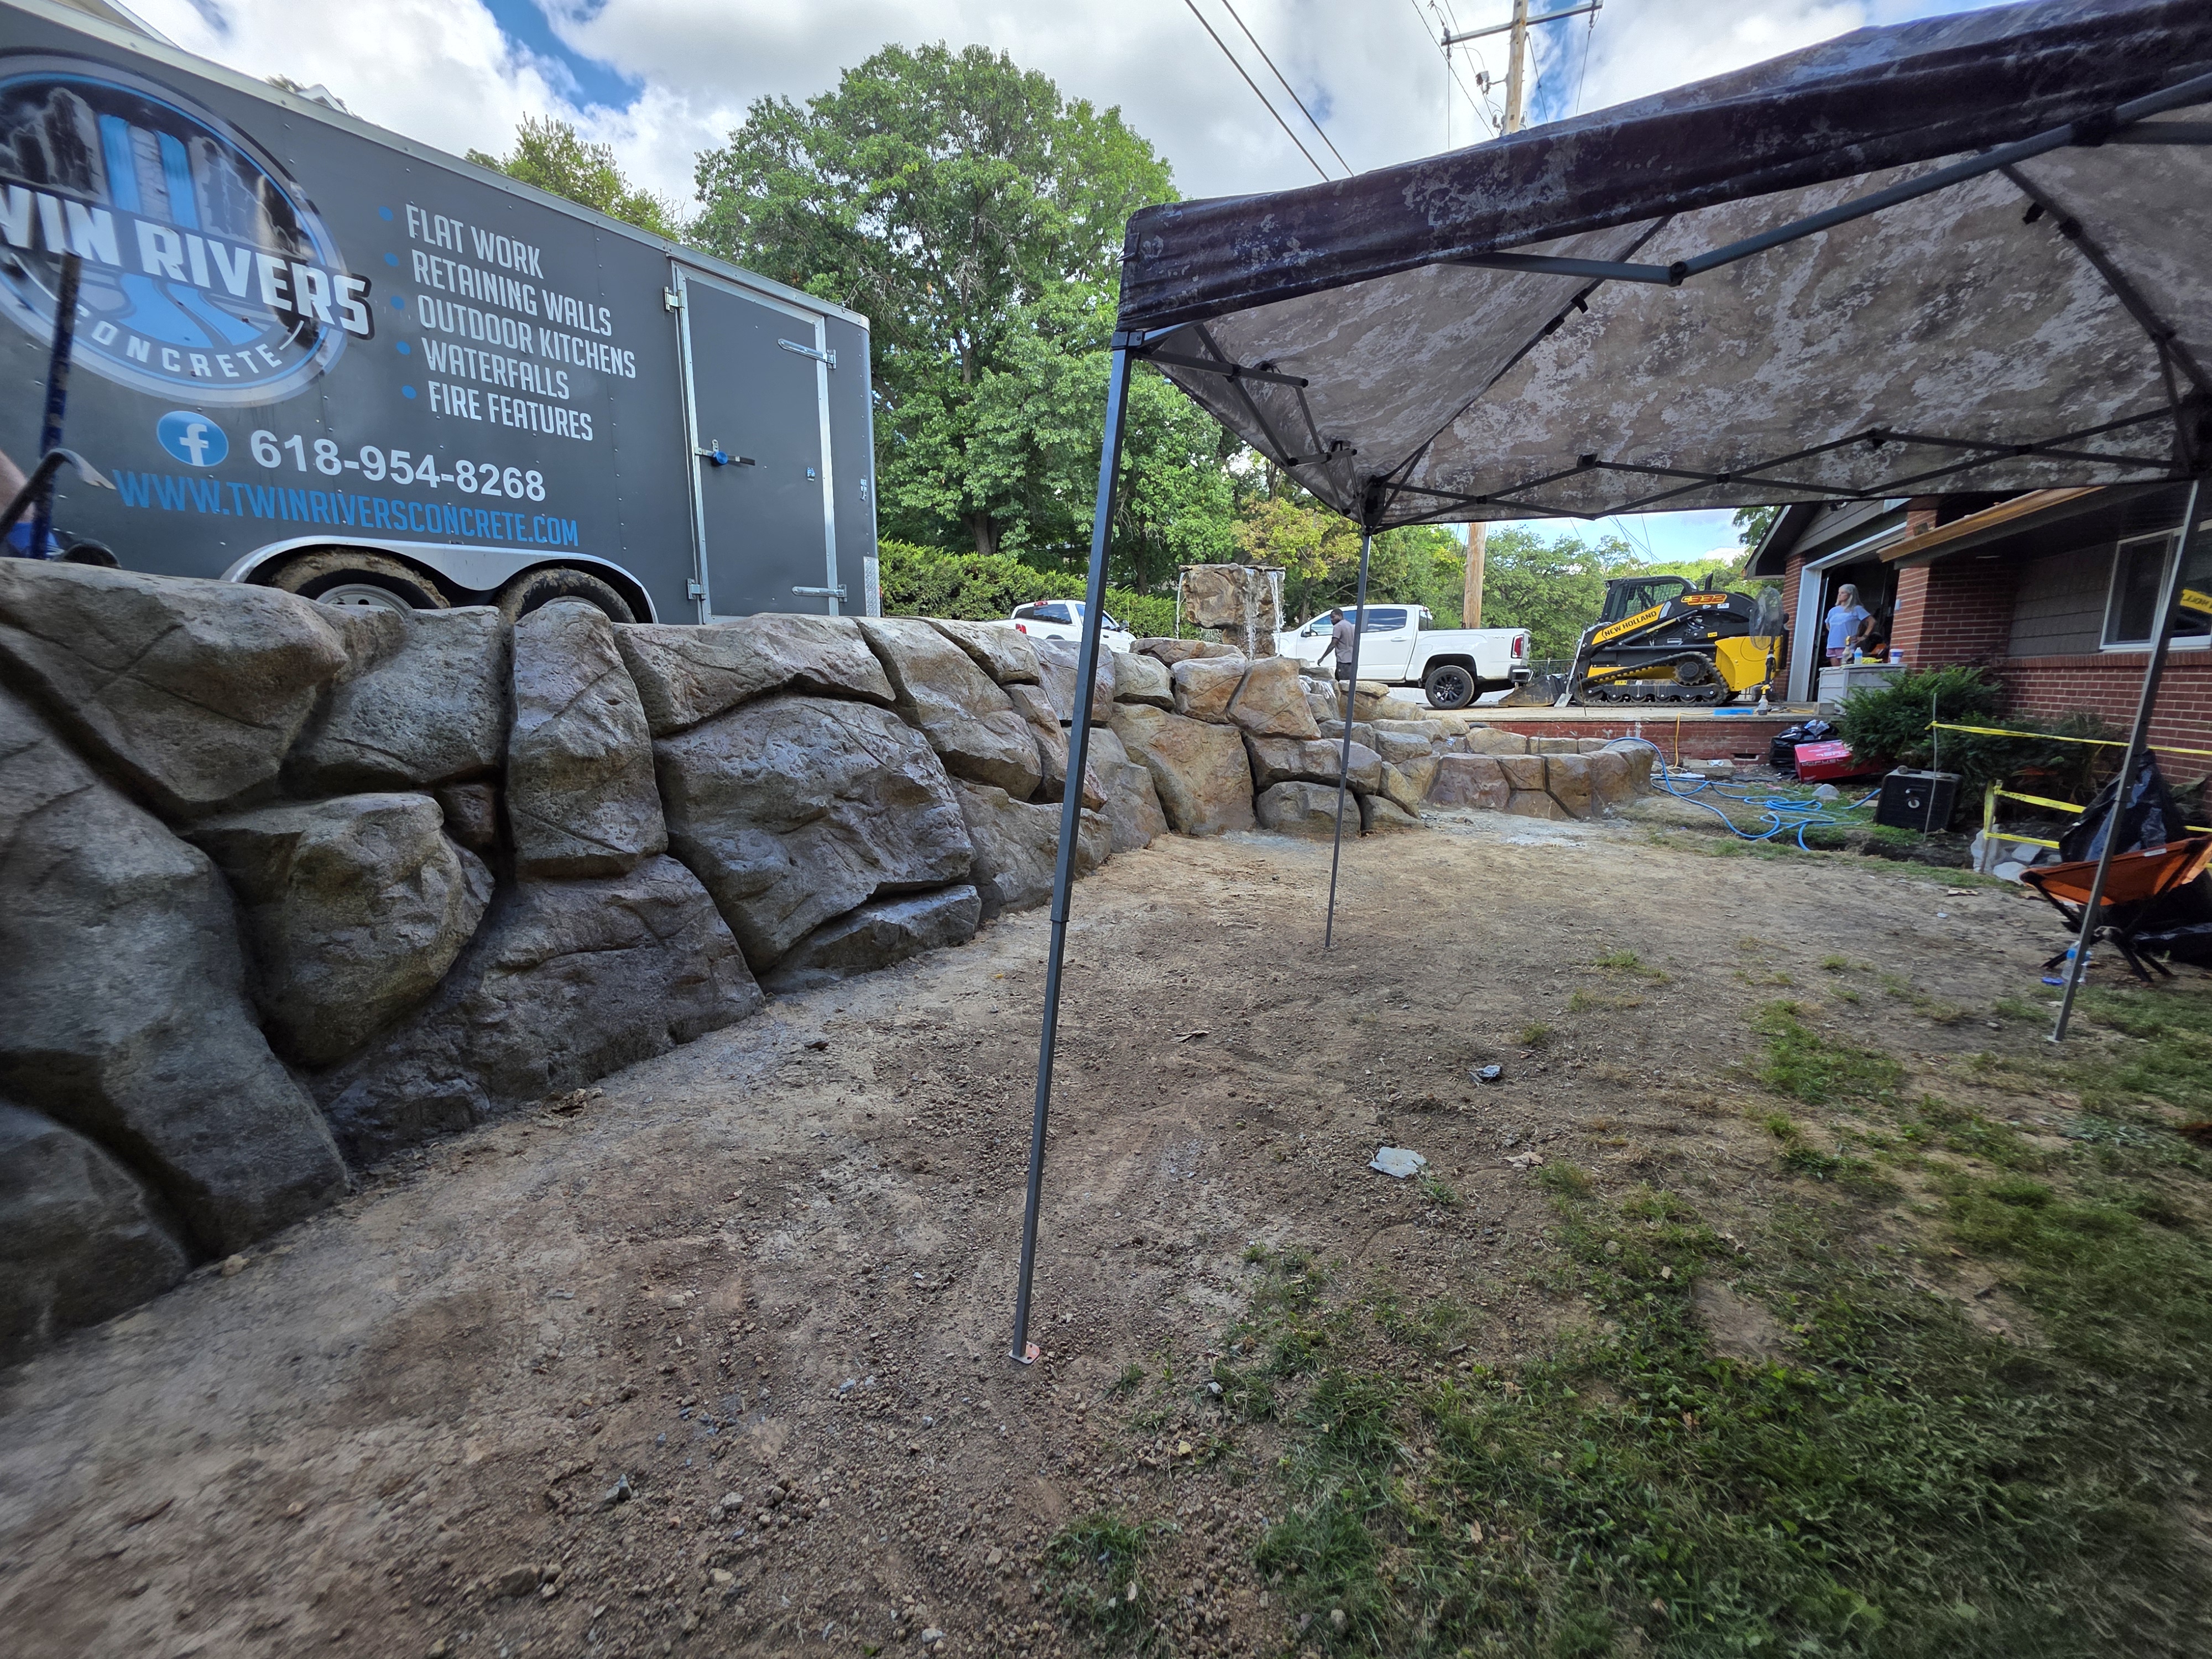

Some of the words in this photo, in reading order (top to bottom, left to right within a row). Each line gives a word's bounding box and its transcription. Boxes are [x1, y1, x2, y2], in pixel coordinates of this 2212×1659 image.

[133, 218, 371, 335] RIVERS
[405, 204, 464, 253] FLAT
[471, 225, 544, 279] WORK
[412, 249, 538, 316] RETAINING
[542, 290, 612, 336] WALLS
[416, 294, 534, 354] OUTDOOR
[539, 327, 636, 378] KITCHENS
[421, 337, 570, 401] WATERFALLS
[428, 381, 482, 421] FIRE
[488, 393, 594, 442] FEATURES
[249, 429, 546, 502] 618-954-8268
[112, 469, 578, 547] WWW.TWINRIVERSCONCRETE.COM
[1604, 625, 1621, 637] NEW
[1622, 611, 1657, 629] HOLLAND
